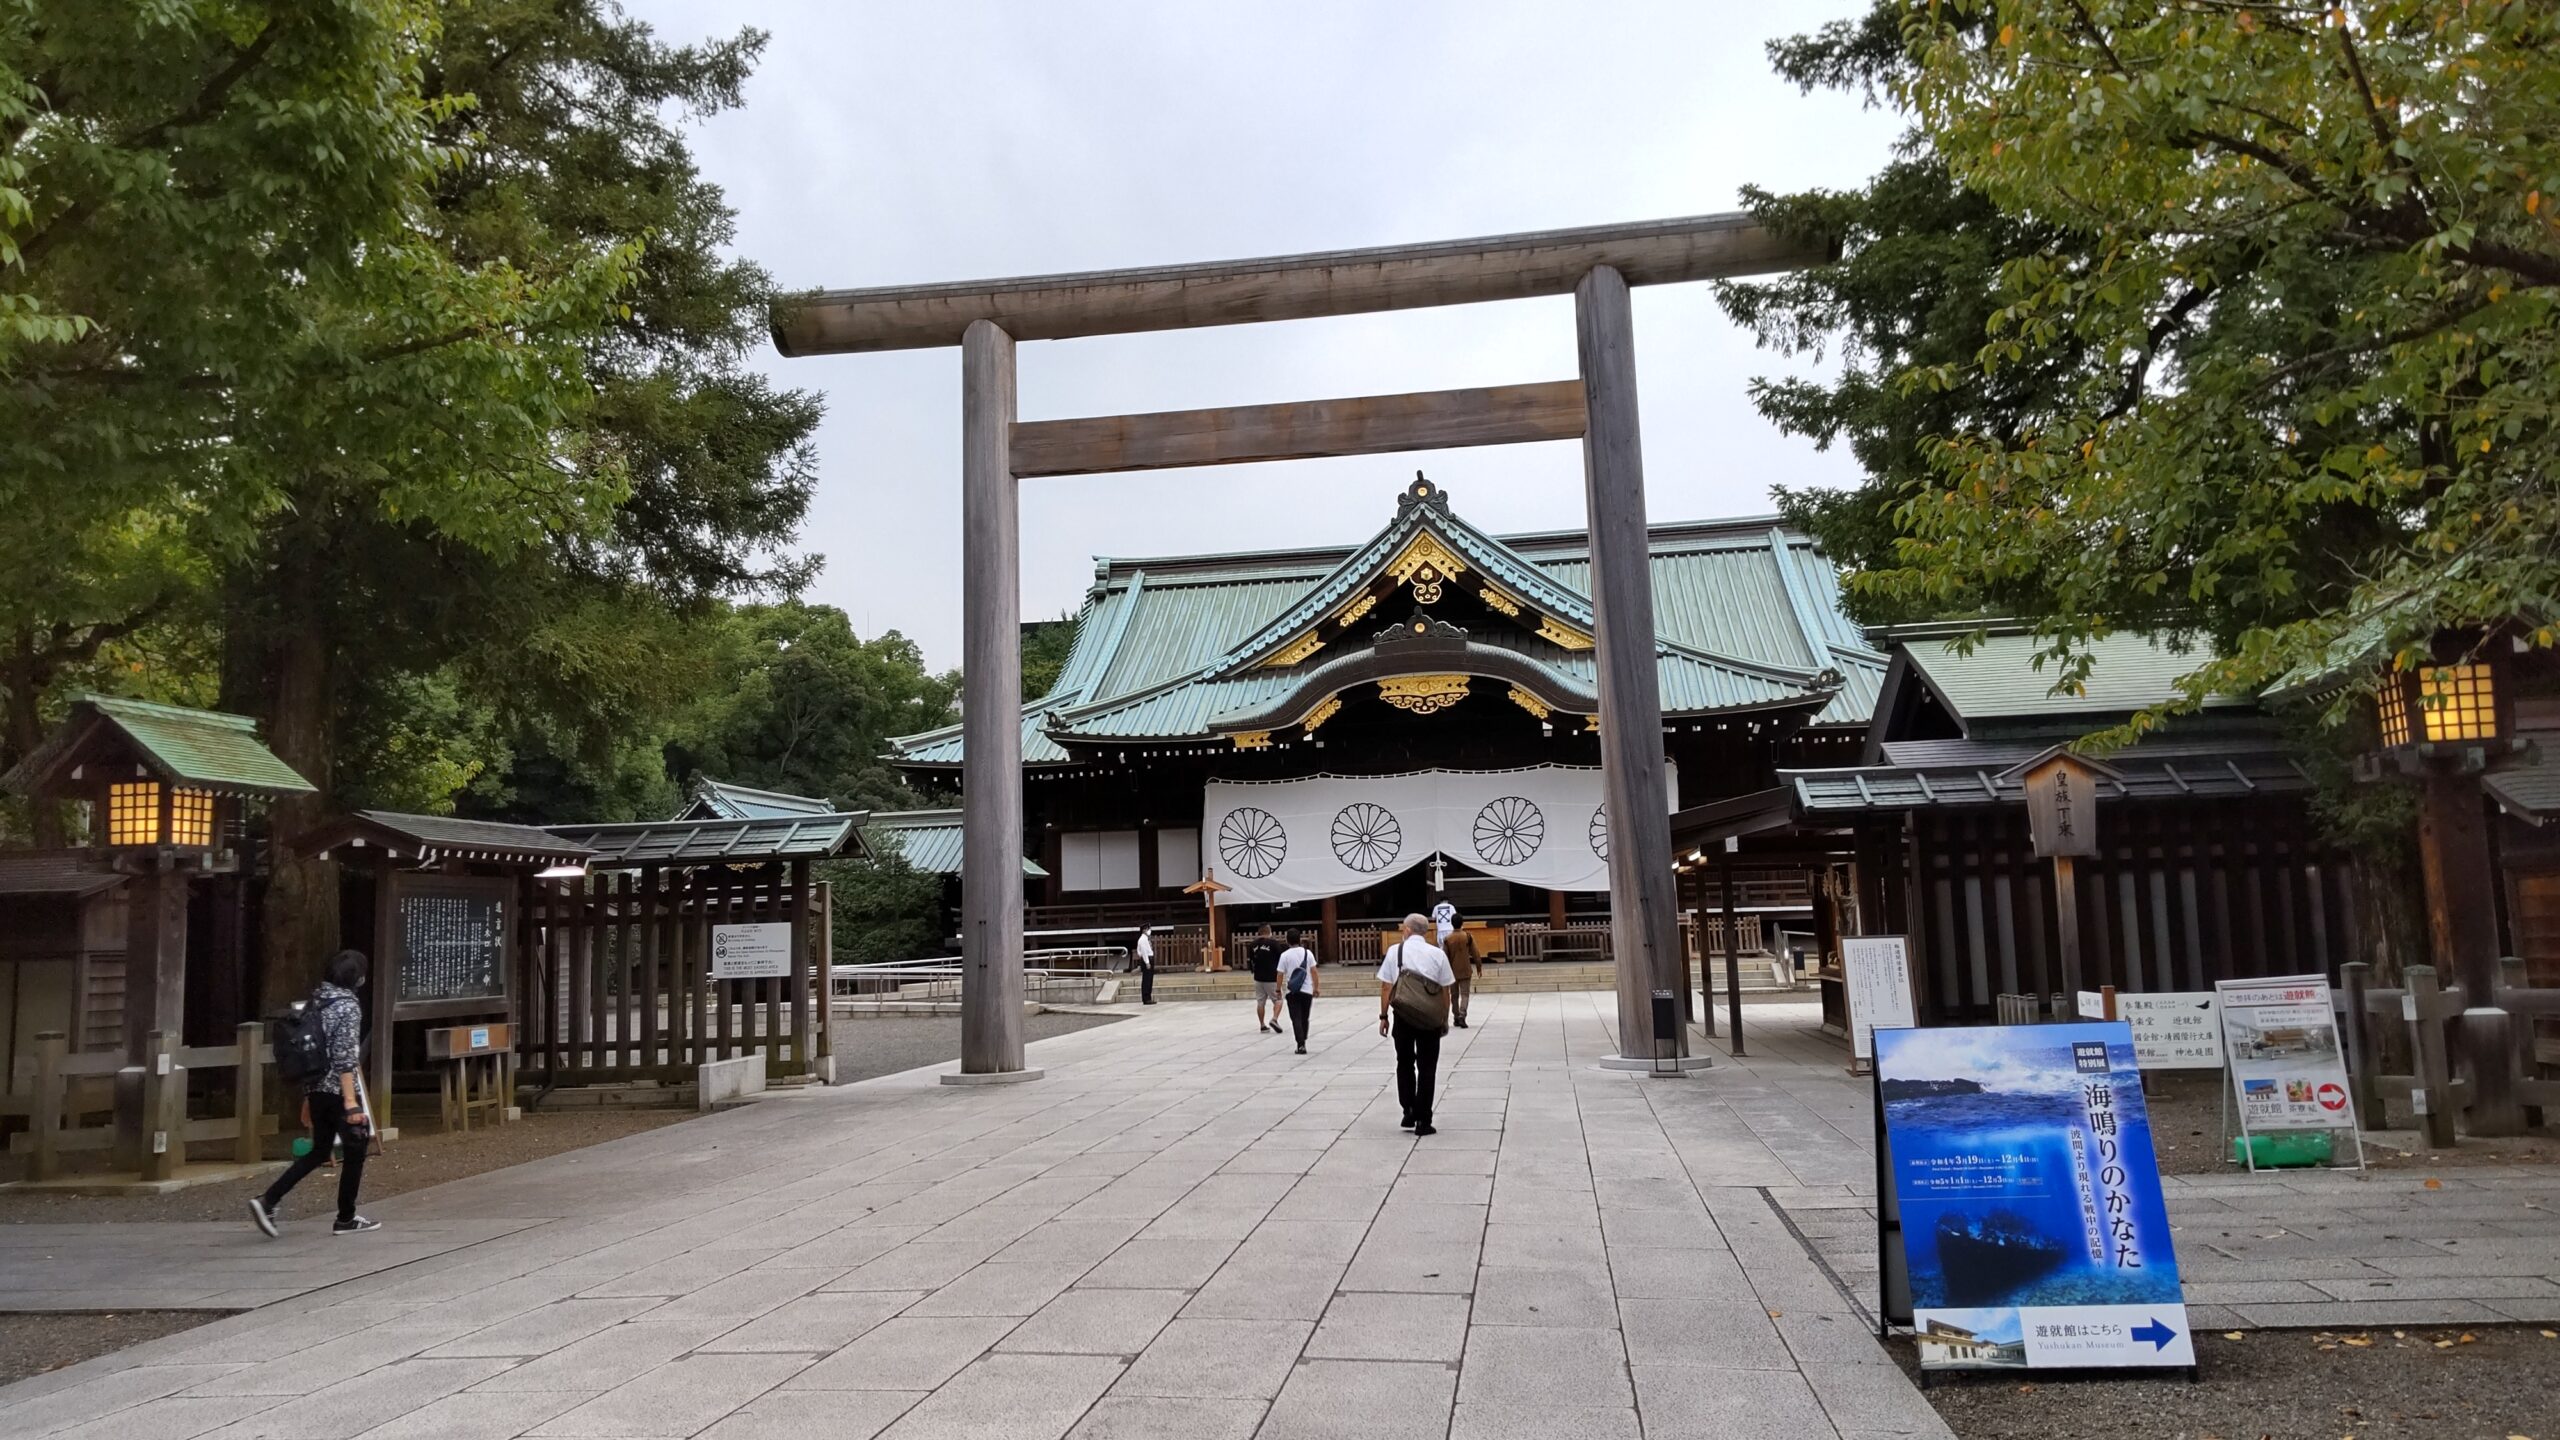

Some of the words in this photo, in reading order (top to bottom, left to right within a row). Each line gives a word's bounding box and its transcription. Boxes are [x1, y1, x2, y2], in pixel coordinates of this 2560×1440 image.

[2055, 769, 2075, 837] 皇族下乗
[2172, 1016, 2203, 1026] 遊就館
[2076, 1047, 2104, 1057] 遊就館
[2248, 1103, 2283, 1115] 遊就館
[2084, 1083, 2142, 1269] 海鳴りのかなた
[2035, 1324, 2122, 1338] 遊就館はこちら
[2037, 1341, 2082, 1350] Yushukan
[2086, 1339, 2124, 1349] Museum
